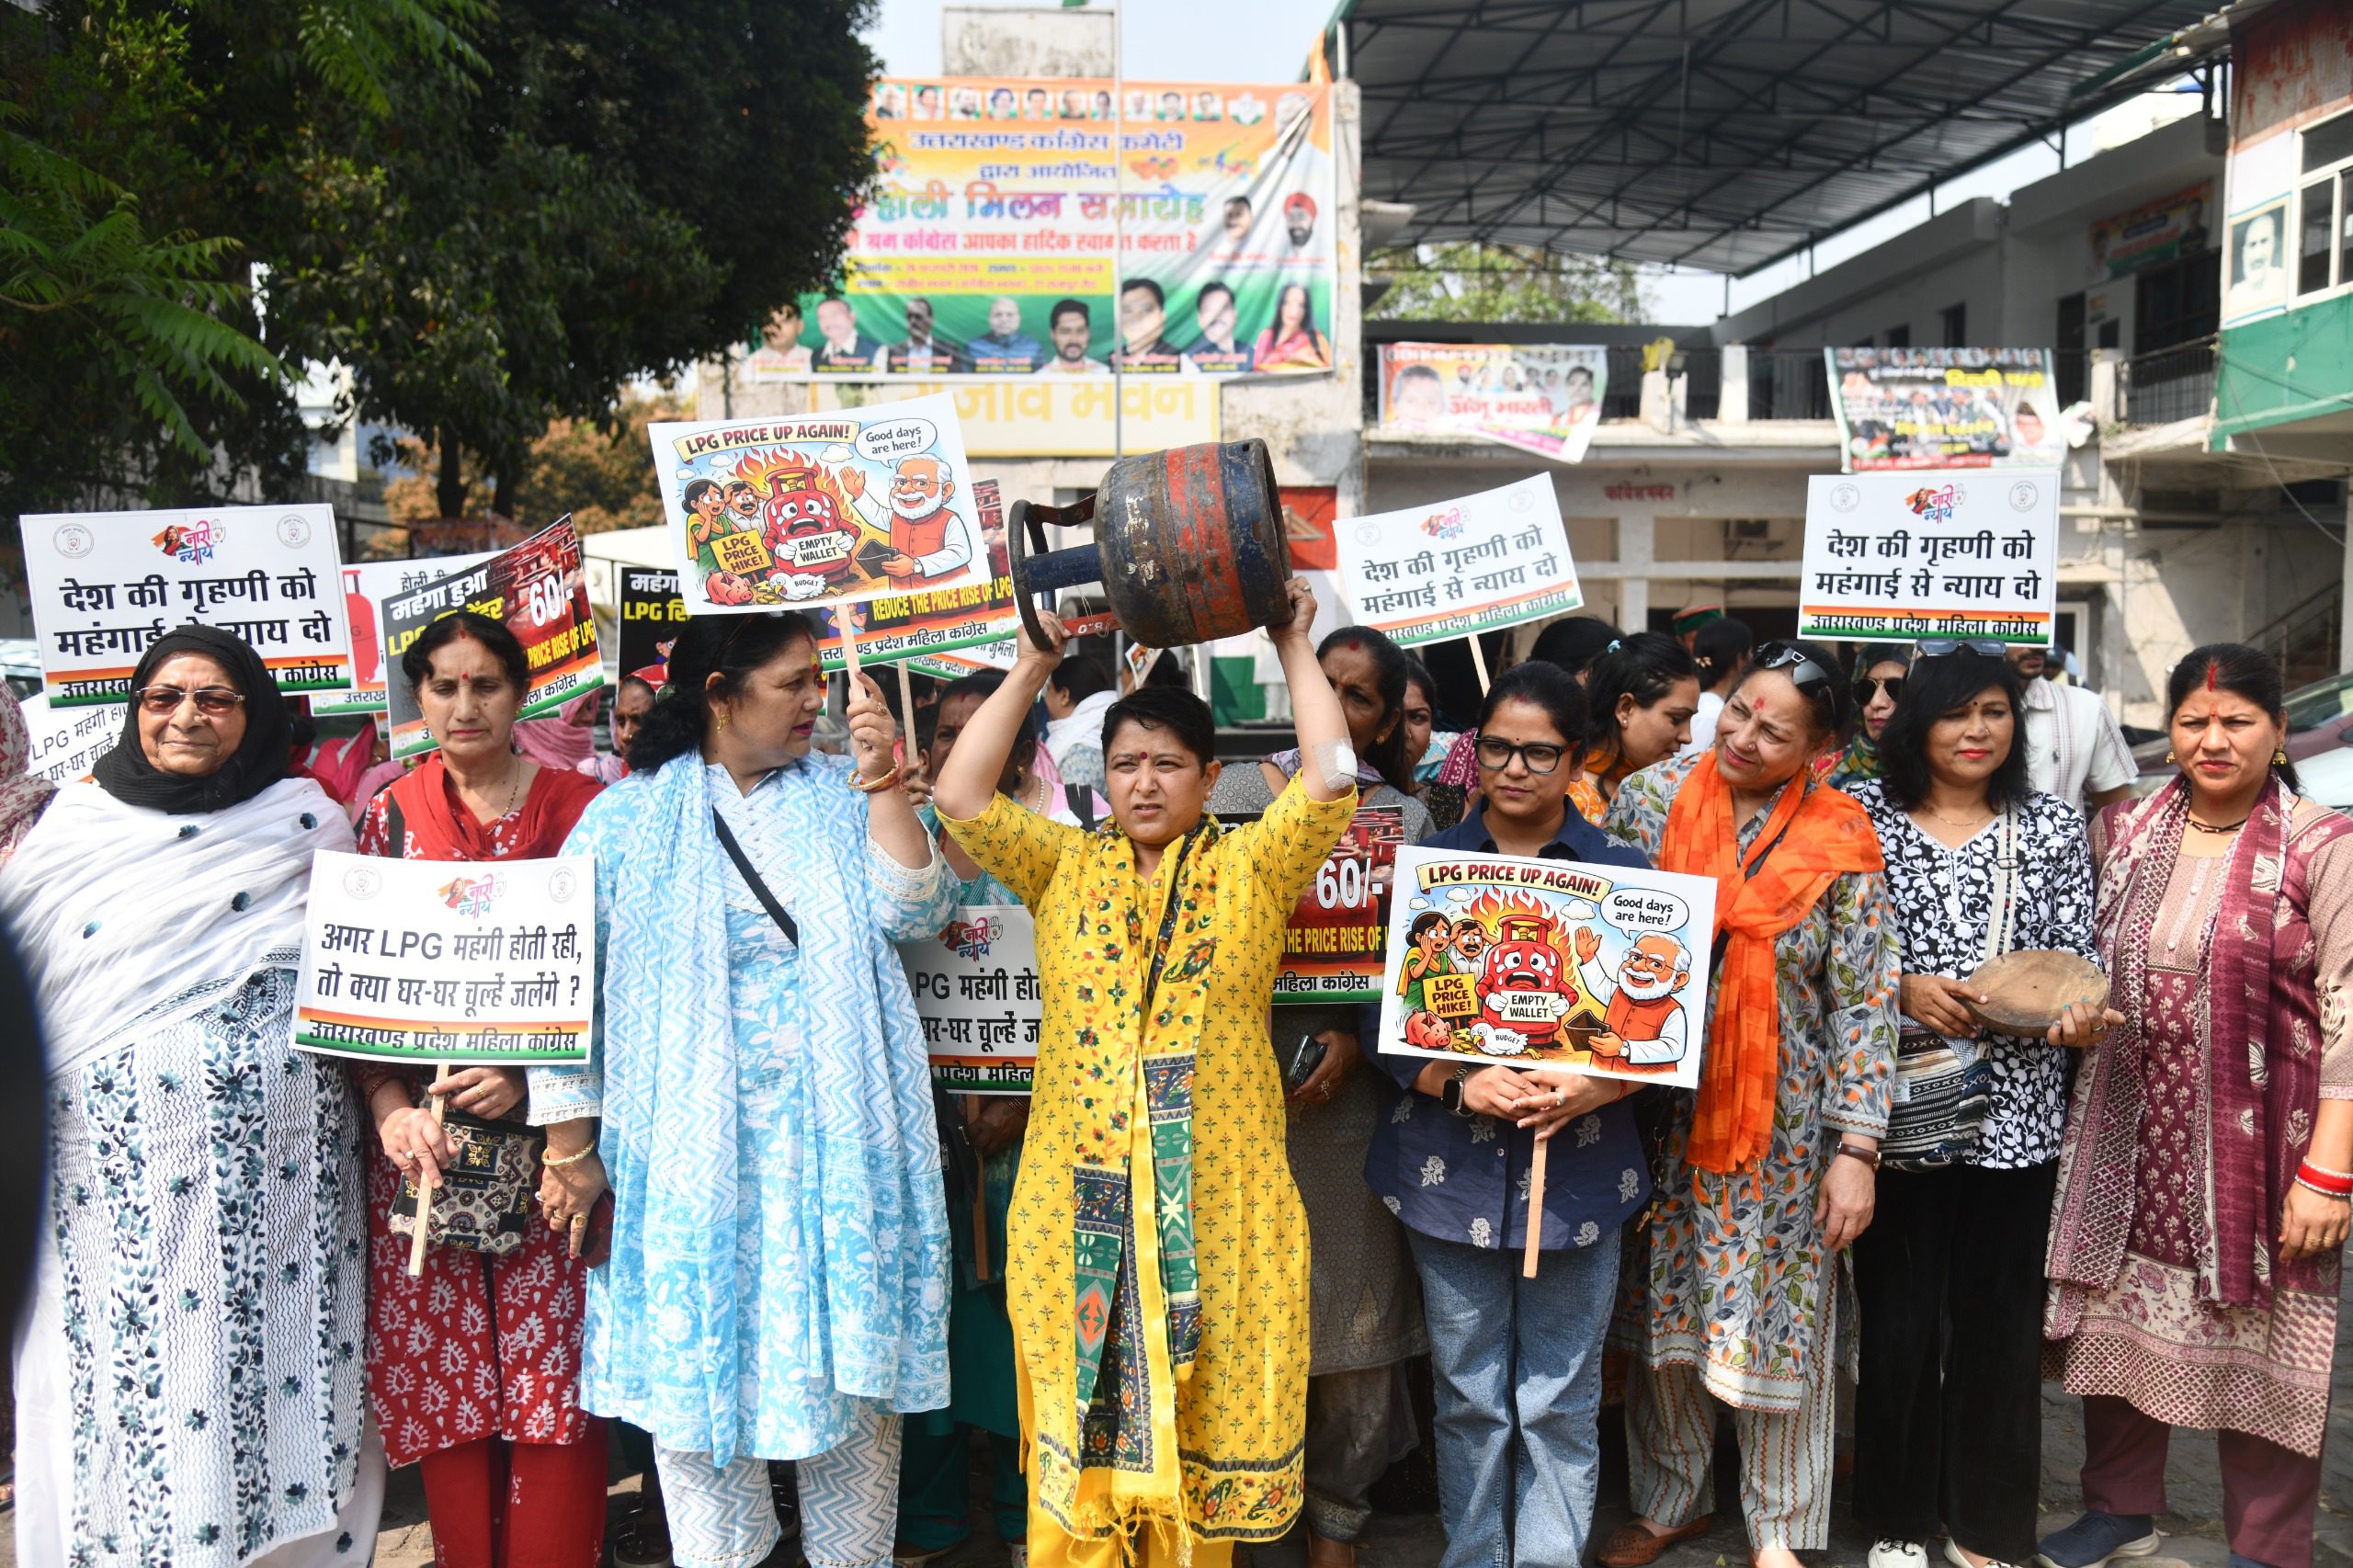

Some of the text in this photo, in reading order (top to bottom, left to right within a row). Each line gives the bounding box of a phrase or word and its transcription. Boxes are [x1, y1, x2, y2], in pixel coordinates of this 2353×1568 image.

[876, 180, 1207, 223] होली मिलन समारोह
[686, 424, 850, 455] LPG PRICE UP AGAIN!
[866, 425, 921, 443] Good days
[871, 437, 921, 453] are here!
[722, 535, 751, 552] LPG
[723, 544, 759, 562] PRICE
[798, 536, 833, 552] EMPTY
[800, 546, 837, 563] WALLET
[1361, 525, 1543, 583] देश की गृहणी को
[1827, 529, 2035, 566] देश की गृहणी को
[731, 554, 764, 573] HIKE!
[59, 567, 316, 613] देश की गृहणी को
[390, 585, 447, 620] महंगा
[449, 567, 488, 607] हुआ
[794, 579, 819, 588] BUDGET
[1361, 553, 1558, 614] महंगाई से न्याय दो
[1815, 568, 2041, 599] महंगाई से न्याय दो
[529, 569, 574, 627] 60/-
[872, 578, 1013, 621] REDUCE THE PRICE RISE OF LPG
[624, 601, 662, 621] LPG
[1476, 602, 1521, 623] महिला
[298, 610, 332, 642] दो
[876, 635, 904, 654] प्रदेश
[908, 629, 946, 648] महिला
[949, 621, 988, 641] कांग्रेस
[1811, 613, 2040, 638] उत्तराखण्ड प्रदेश महिला कांग्रेस
[528, 619, 596, 670] PRICE RISE OF LPG
[58, 659, 338, 699] उत्तराख कांग्रेस
[544, 674, 577, 697] कांग्रेस
[345, 690, 386, 704] उत्तराख
[32, 730, 69, 761] LPG
[1316, 858, 1382, 909] 60/-
[1429, 865, 1601, 897] LPG PRICE UP AGAIN!
[1613, 894, 1674, 915] Good days
[1615, 912, 1671, 926] are here!
[322, 923, 582, 965] अगर LPG महंगी होती रही,
[1304, 927, 1337, 953] PRICE
[1340, 926, 1365, 951] RISE
[1368, 926, 1381, 951] OF
[318, 962, 343, 997] तो
[350, 972, 391, 1003] क्या
[397, 978, 460, 1007] घर-घर
[511, 971, 560, 1007] जलेंगे
[571, 975, 580, 1006] ?
[915, 971, 950, 999] PG
[959, 968, 1008, 1001] महंगी
[1322, 971, 1370, 993] कांग्रेस
[1434, 978, 1464, 992] LPG
[1432, 988, 1469, 1003] PRICE
[1436, 1000, 1472, 1014] HIKE!
[1511, 994, 1547, 1006] EMPTY
[1509, 1006, 1549, 1018] WALLET
[309, 1019, 578, 1052] उत्तराखण्ड प्रदेश महिला कांग्रेस
[1495, 1033, 1519, 1045] BUDGET
[938, 1060, 982, 1083] प्रदेश
